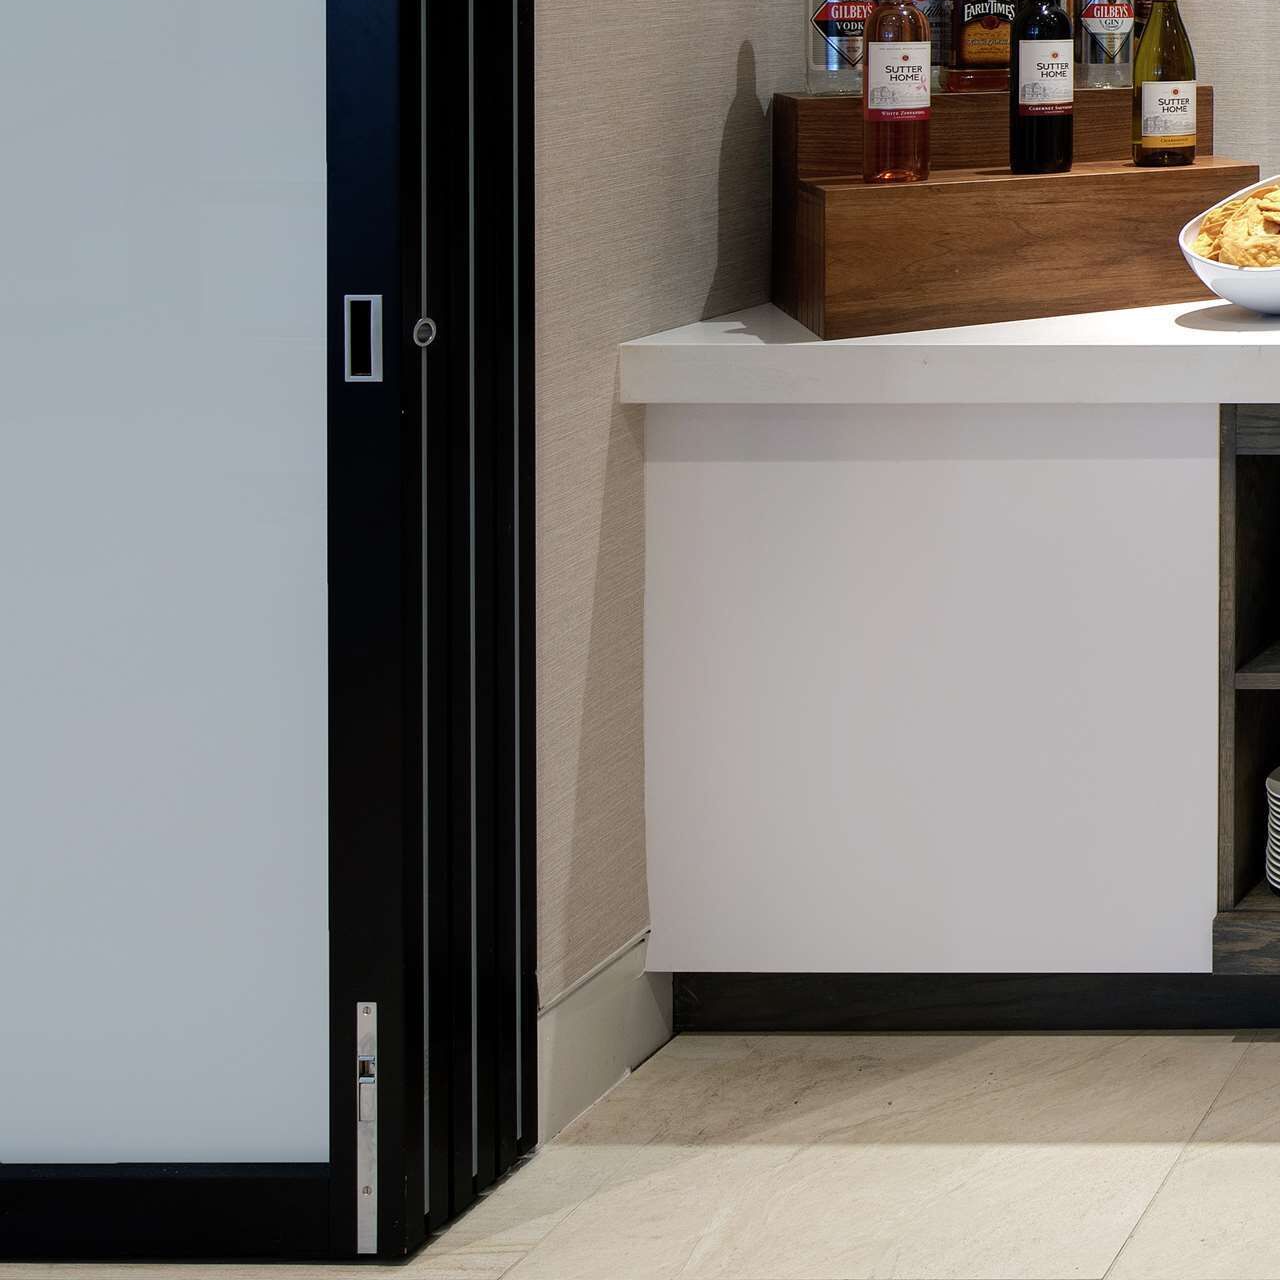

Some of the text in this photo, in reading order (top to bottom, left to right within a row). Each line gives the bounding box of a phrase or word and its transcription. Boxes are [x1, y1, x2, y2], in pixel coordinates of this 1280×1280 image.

[836, 21, 864, 30] VODK
[885, 65, 923, 74] SUTTER
[1036, 62, 1070, 71] SUTTER
[890, 74, 920, 82] HOME
[1041, 70, 1068, 78] HOME
[1158, 97, 1190, 106] SUTTER
[1162, 105, 1188, 113] HOME
